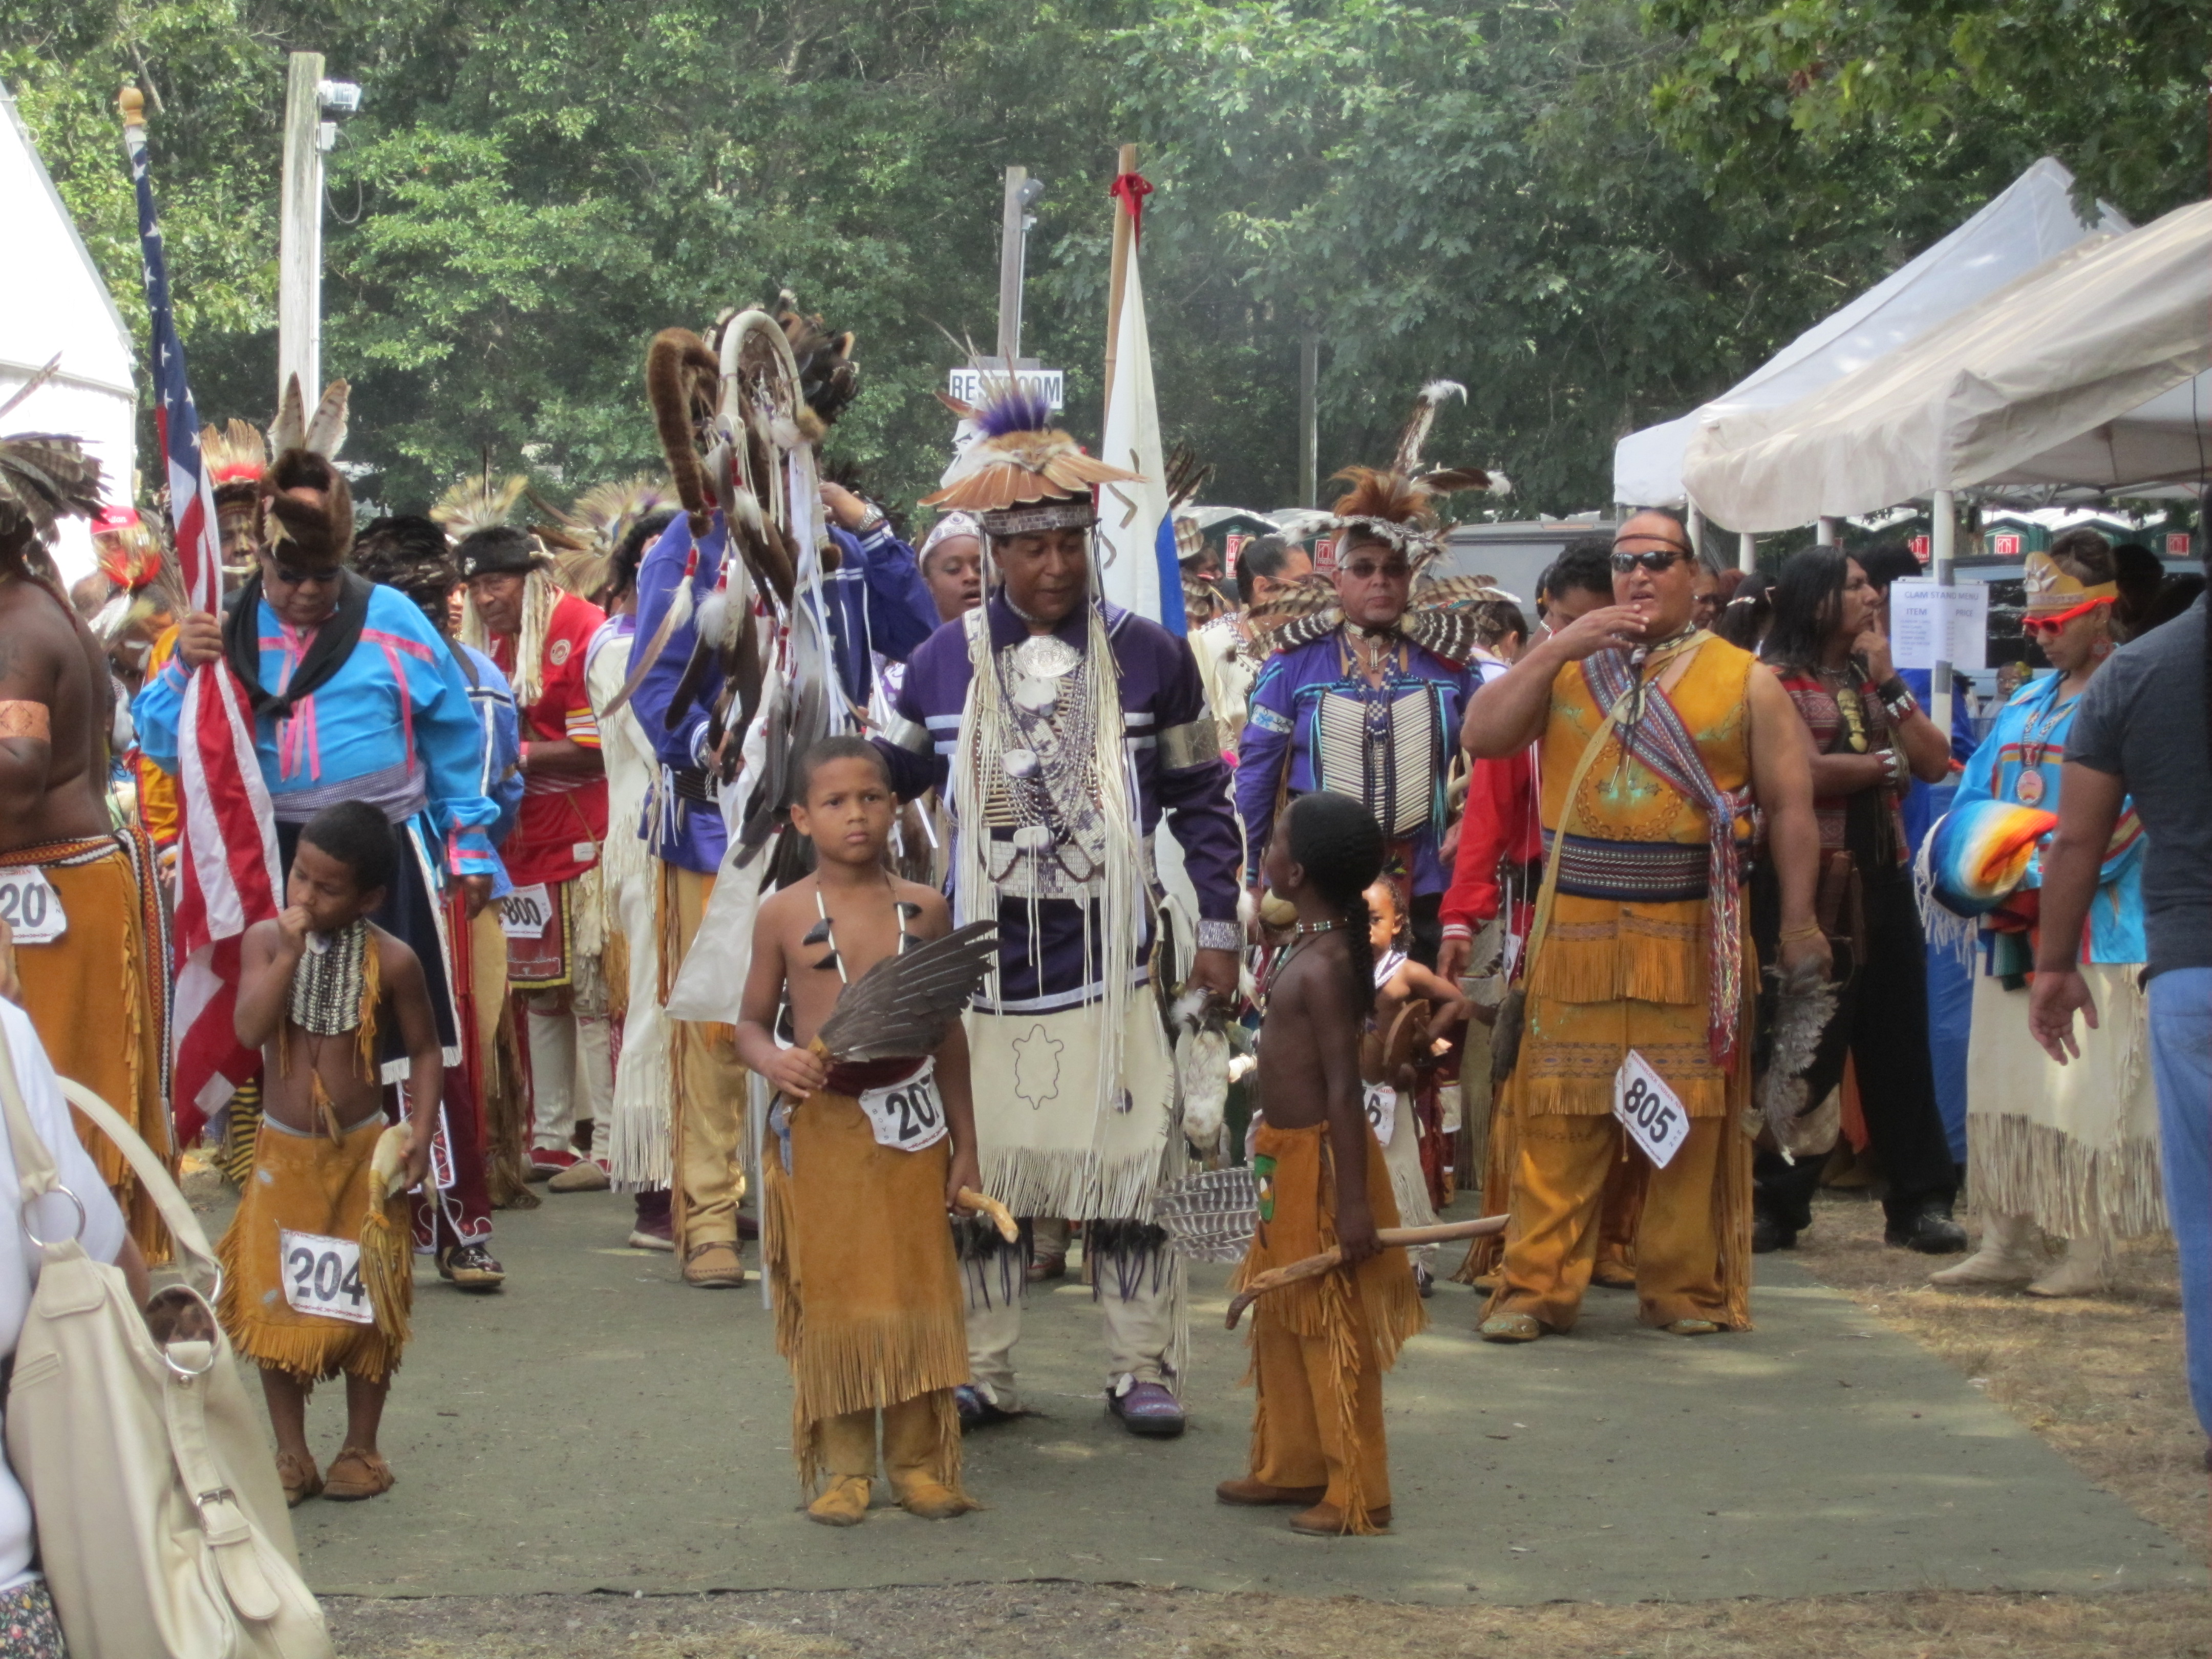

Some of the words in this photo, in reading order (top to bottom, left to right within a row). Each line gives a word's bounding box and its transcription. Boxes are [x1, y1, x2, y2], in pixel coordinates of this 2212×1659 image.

[1955, 609, 1973, 617] PRICE
[872, 1108, 889, 1140] BOYS
[1625, 1077, 1677, 1143] 805
[288, 1247, 366, 1306] 204
